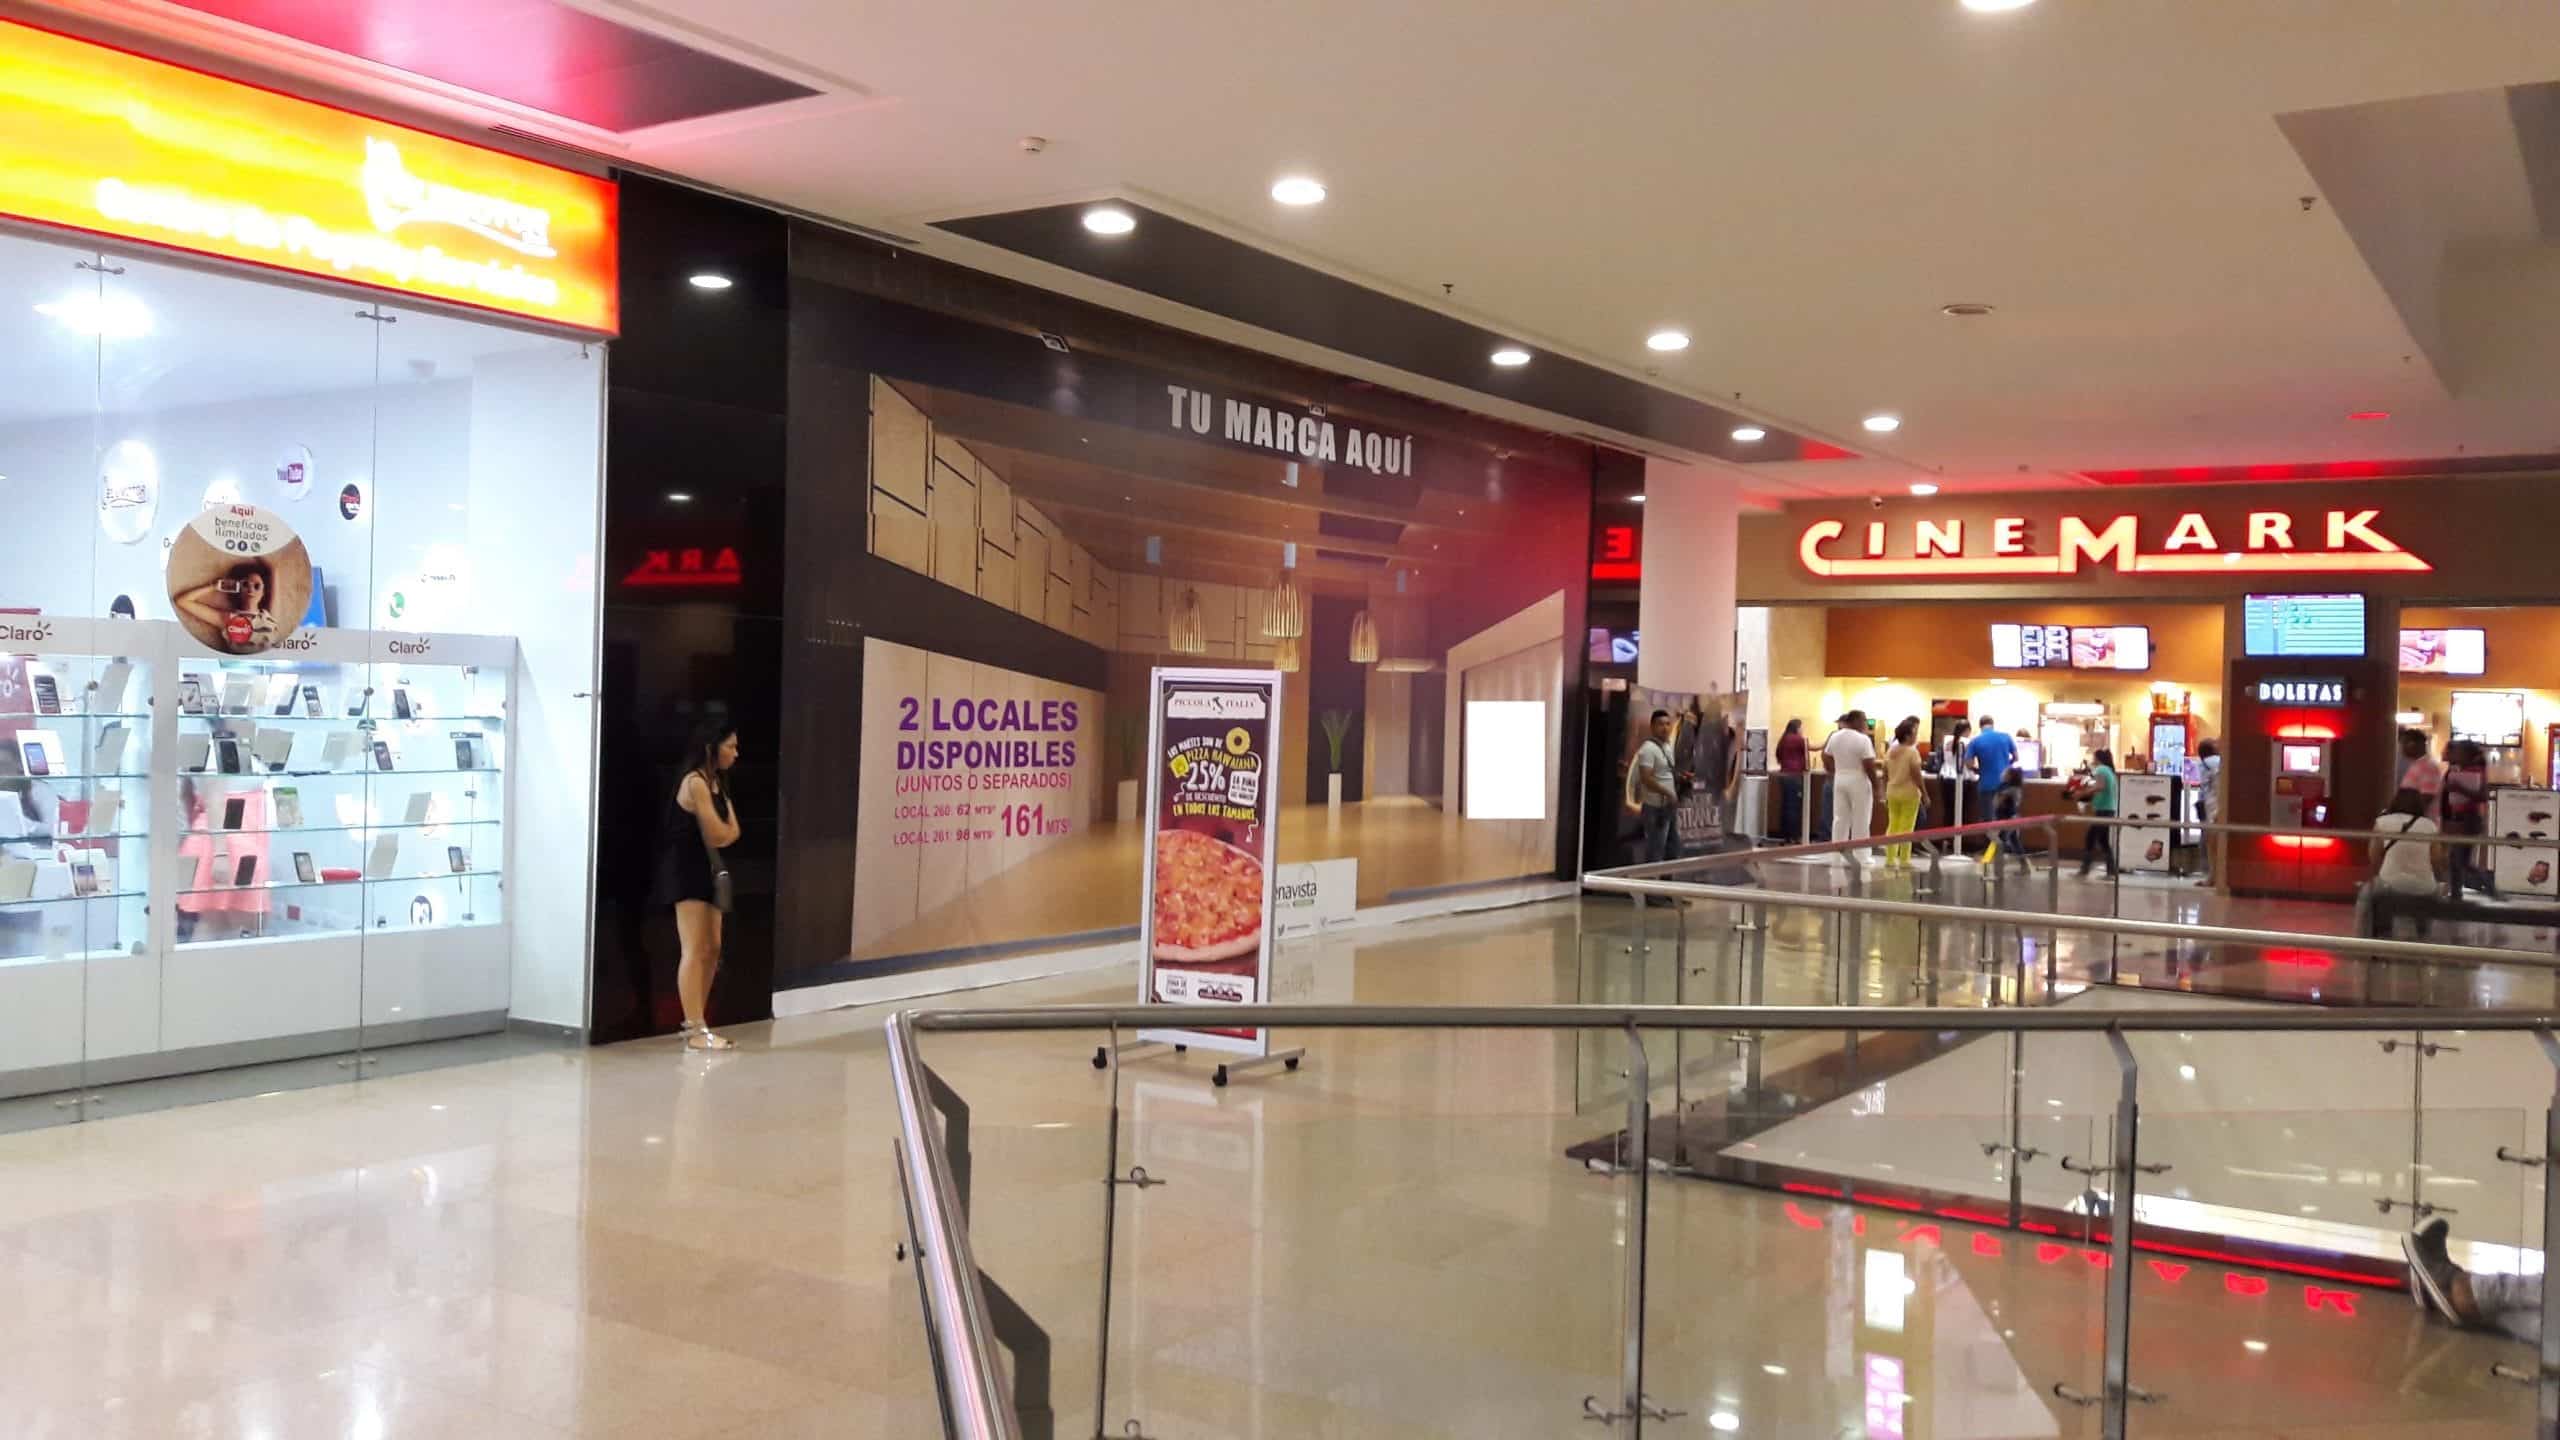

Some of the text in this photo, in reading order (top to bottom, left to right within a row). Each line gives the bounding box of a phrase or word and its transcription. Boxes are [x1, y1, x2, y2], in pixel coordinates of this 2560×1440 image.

[1167, 384, 1415, 477] TU MARCA AQUÍ
[214, 516, 270, 532] beneficios
[214, 528, 269, 542] ilimitados
[1800, 510, 2433, 576] CINEMARK
[0, 624, 46, 641] Claro
[389, 640, 427, 654] Claro
[898, 696, 1078, 732] 2 LOCALES
[897, 740, 1076, 770] DISPONIBLES
[895, 771, 1072, 796] (JUNTOS O SEPARADOS)
[1186, 760, 1226, 791] 25%
[894, 806, 930, 819] LOCAL
[1001, 803, 1043, 837] 161
[893, 831, 930, 845] LOCAL
